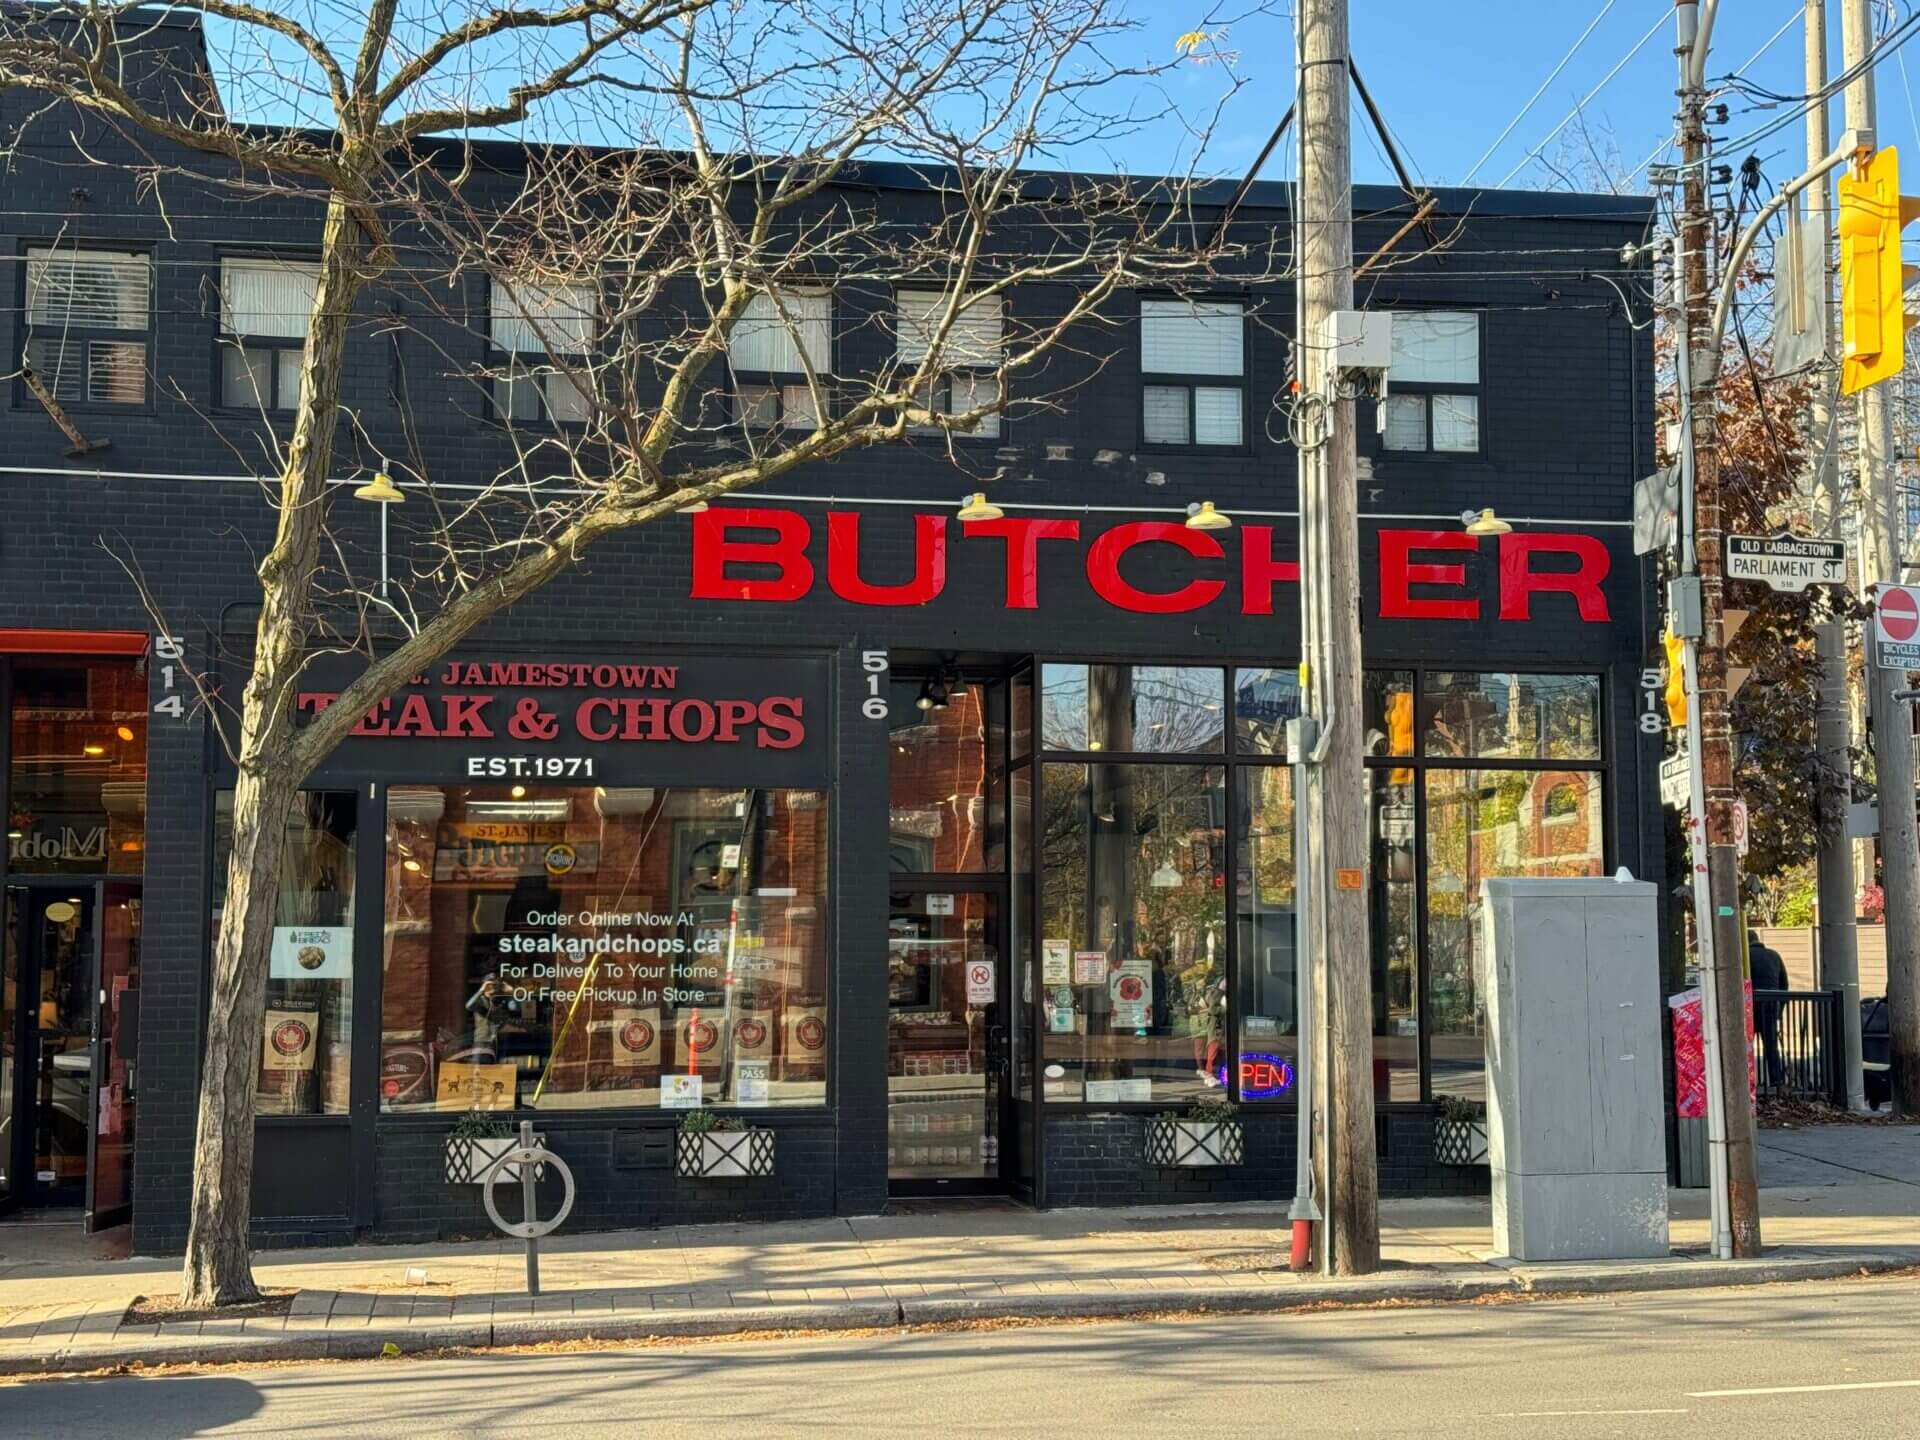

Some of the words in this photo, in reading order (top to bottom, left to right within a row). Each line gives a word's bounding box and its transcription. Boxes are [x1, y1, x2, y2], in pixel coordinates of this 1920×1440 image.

[1741, 540, 1760, 552] OLD
[1764, 542, 1834, 556] CABBAGETOWN
[1734, 558, 1815, 577] PARLIAMENT
[1822, 561, 1841, 579] ST.
[1883, 643, 1920, 655] BICYCLES
[153, 636, 184, 718] 514
[441, 661, 679, 689] JAMESTOWN
[862, 650, 889, 720] 516
[1640, 668, 1664, 734] 518
[508, 700, 558, 740] &
[576, 697, 806, 749] CHOPS
[467, 757, 594, 777] EST.1971
[526, 910, 573, 927] Order
[578, 910, 632, 927] Online
[635, 911, 673, 926] Now
[676, 911, 695, 926] At
[498, 933, 721, 957] steakandchops.ca
[500, 963, 527, 978] For
[533, 963, 599, 982] Delivery
[604, 962, 624, 978] To
[628, 962, 667, 978] Your
[671, 962, 719, 978] Home
[512, 987, 534, 1003] Or
[538, 987, 577, 1003] Free
[583, 987, 637, 1007] Pickup
[642, 987, 657, 1002] In
[662, 987, 704, 1003] Store
[741, 1069, 765, 1079] PASS
